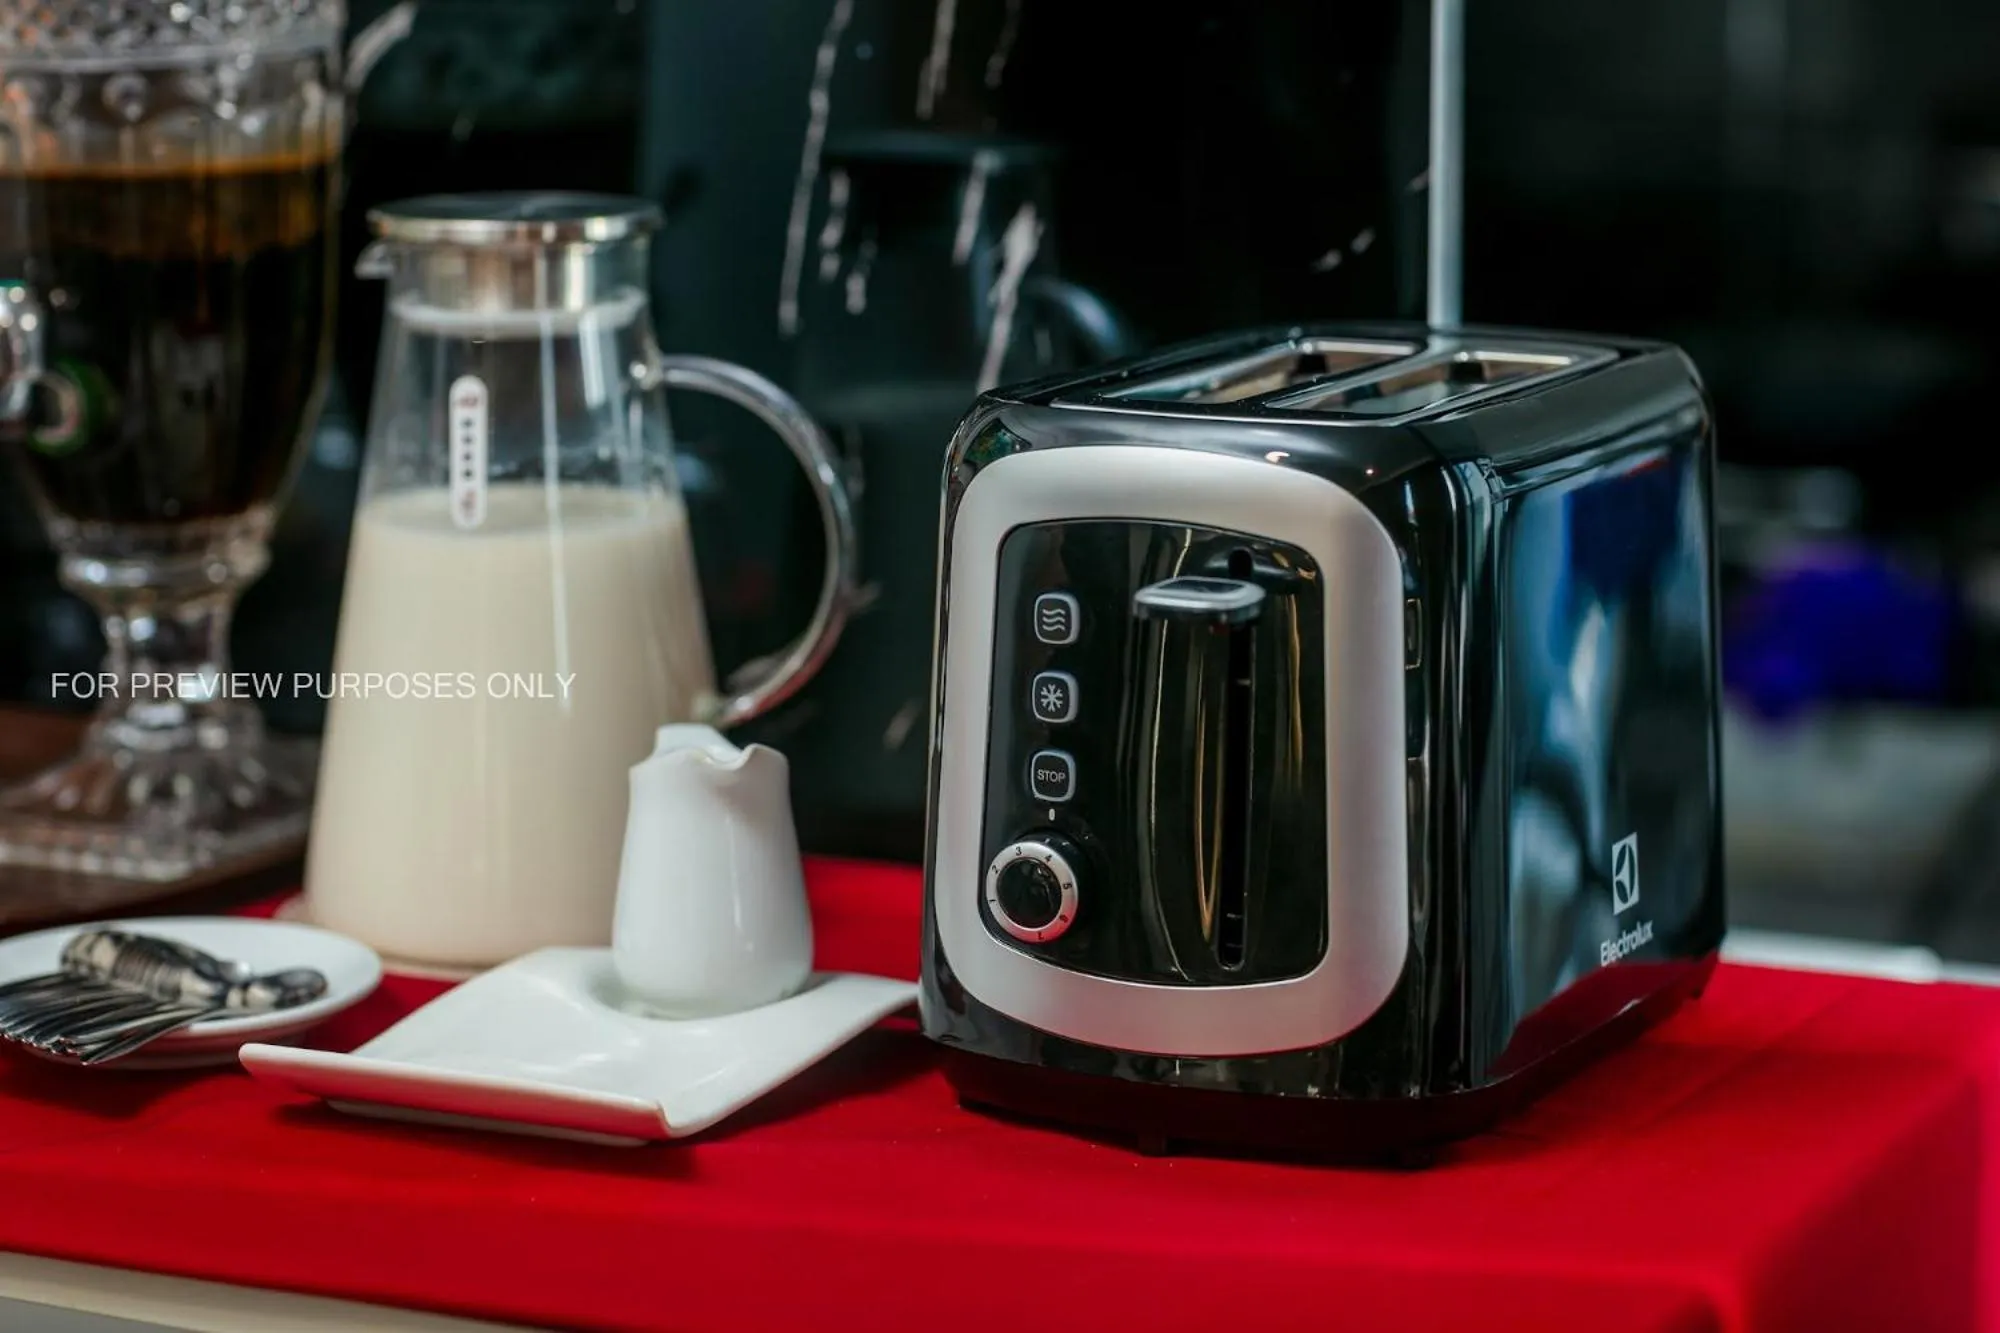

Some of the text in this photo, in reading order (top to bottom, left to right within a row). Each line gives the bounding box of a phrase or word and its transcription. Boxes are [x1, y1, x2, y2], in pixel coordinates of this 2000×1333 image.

[1037, 768, 1066, 783] STOP
[1015, 846, 1022, 856] 3
[991, 864, 999, 874] 2
[1600, 919, 1654, 968] Electrolux
